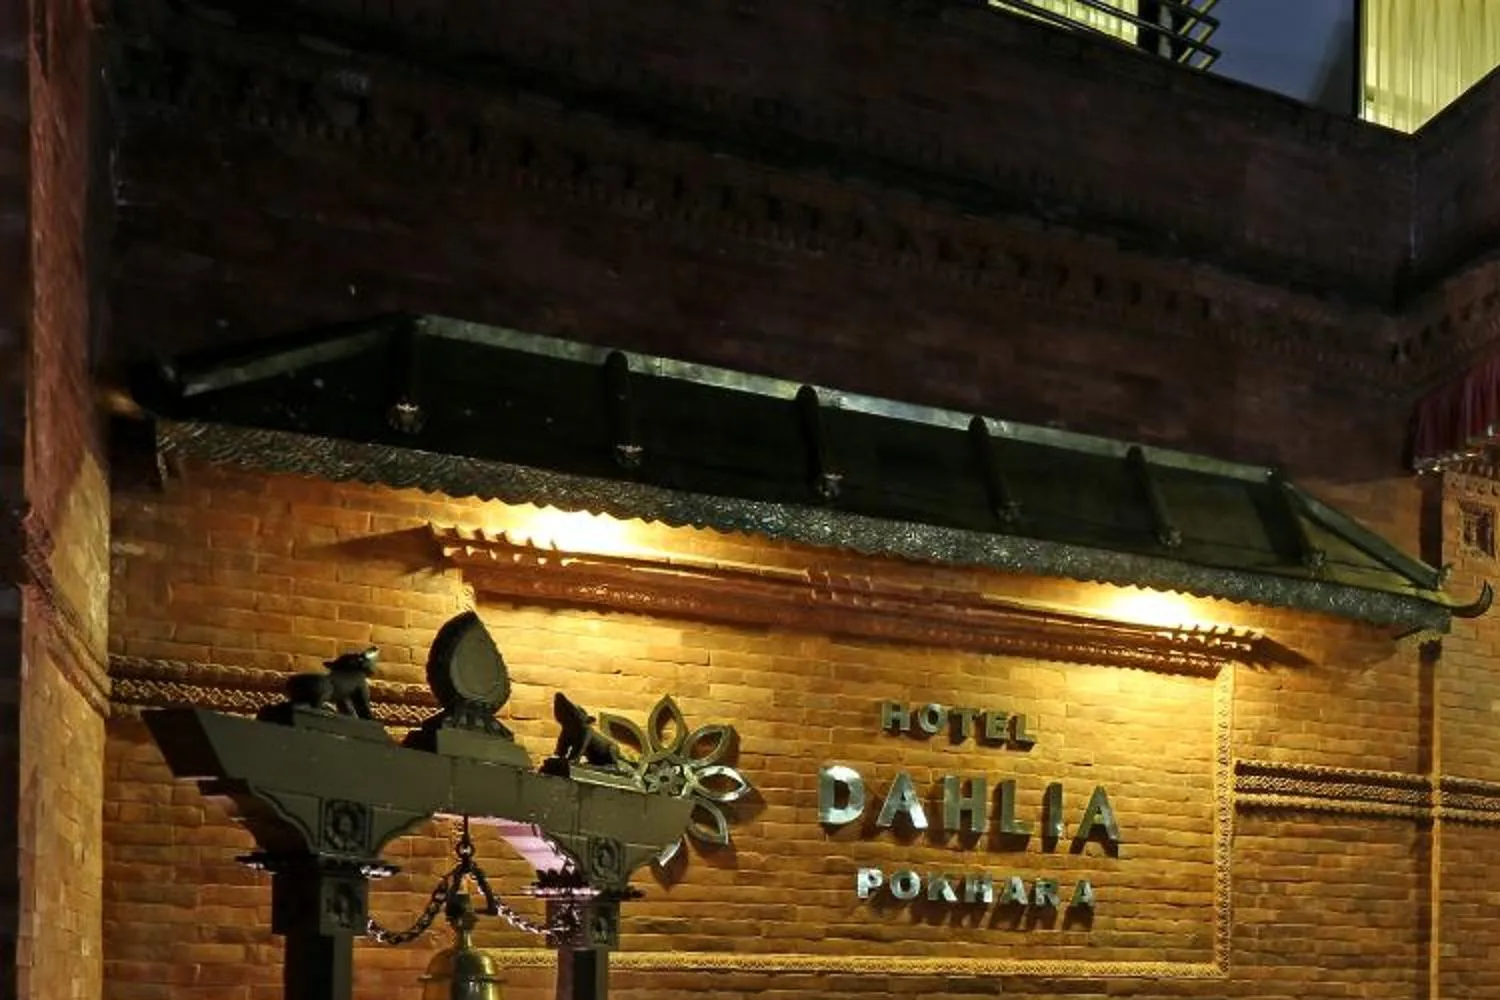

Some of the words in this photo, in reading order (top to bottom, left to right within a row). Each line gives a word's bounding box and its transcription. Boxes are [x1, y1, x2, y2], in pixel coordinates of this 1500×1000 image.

[882, 702, 1036, 743] HOTEL
[817, 765, 1121, 841] DAHLIA
[856, 867, 1094, 907] POKHARA
